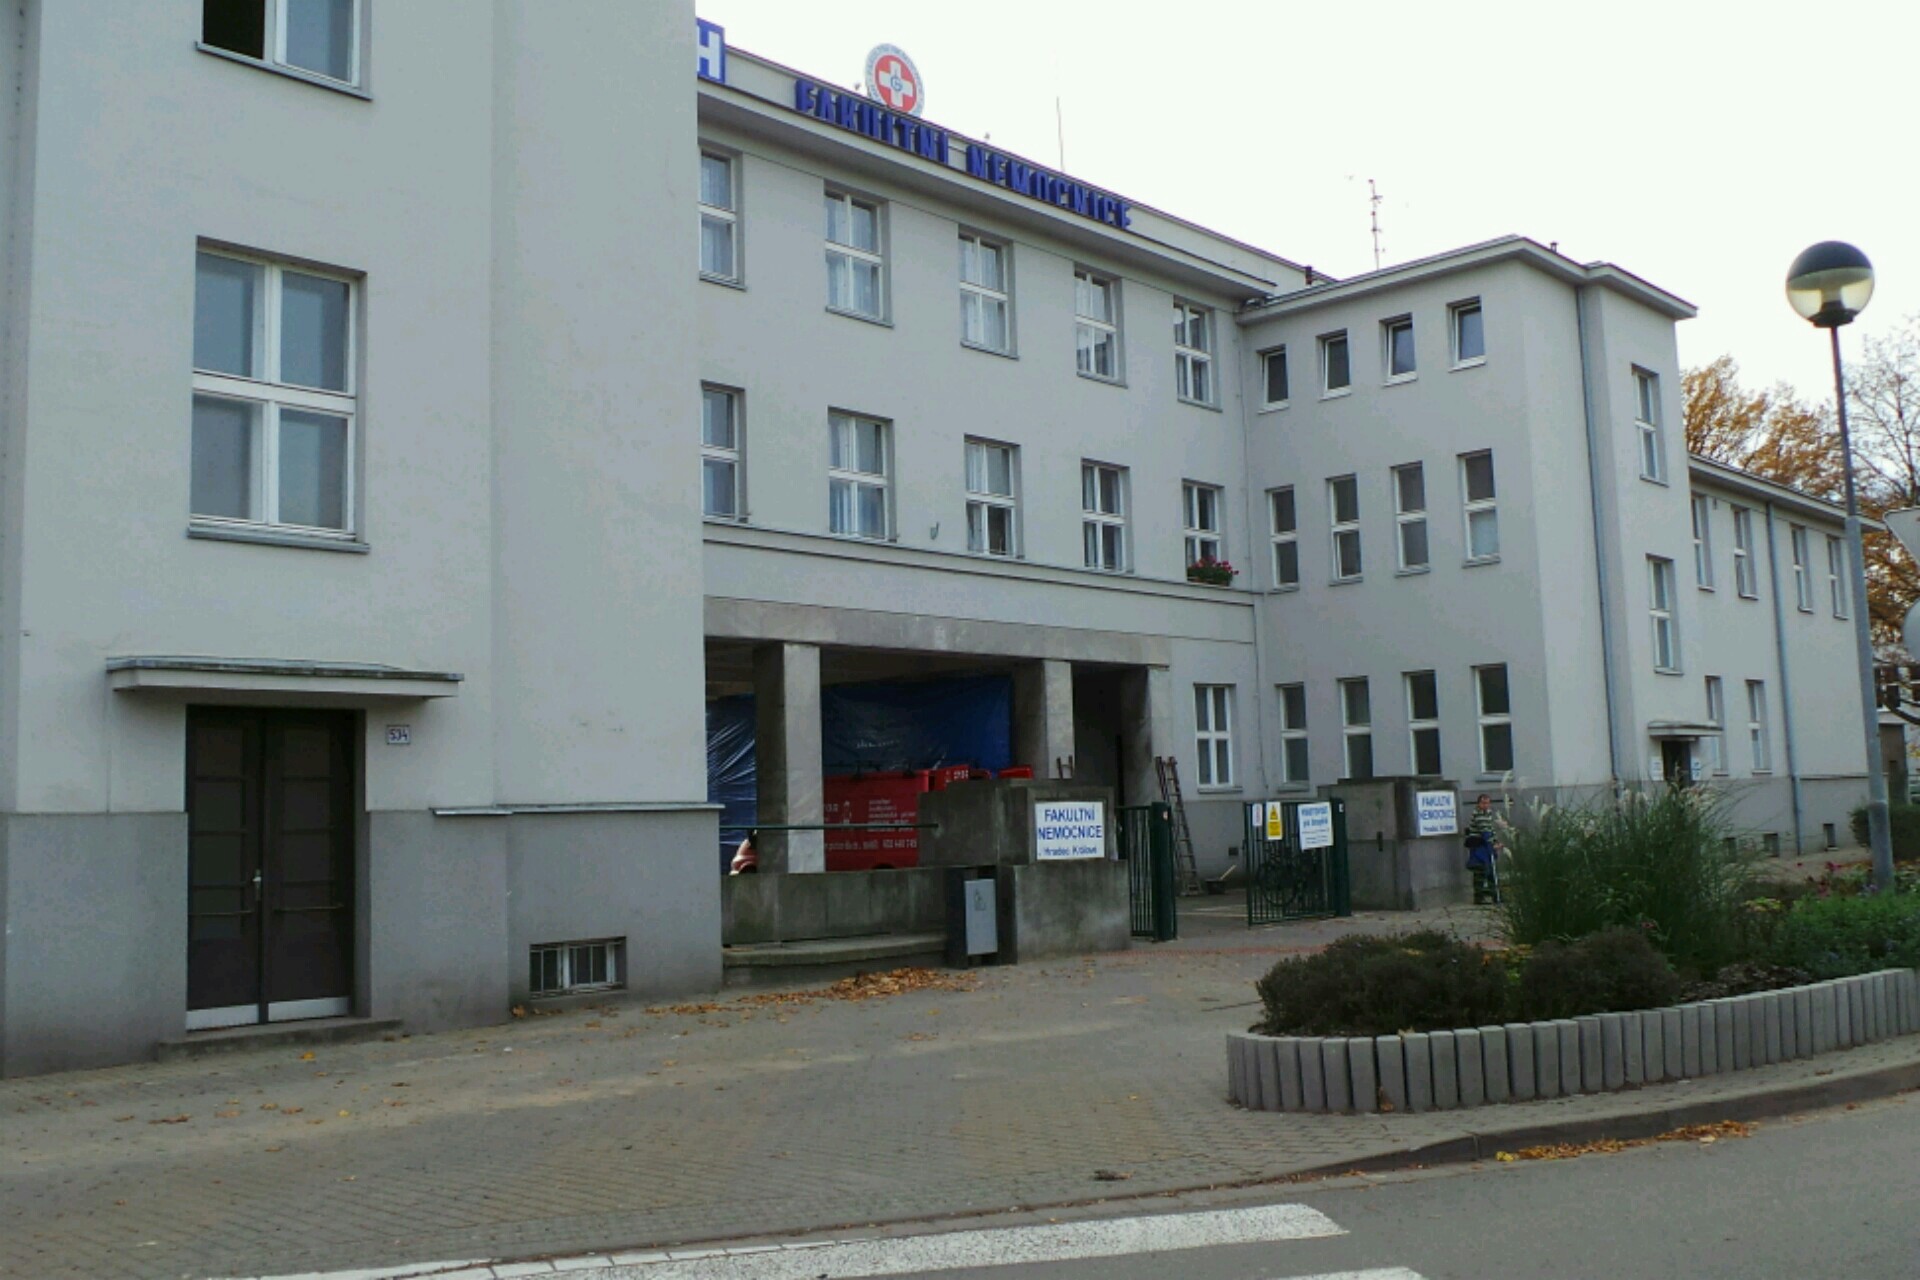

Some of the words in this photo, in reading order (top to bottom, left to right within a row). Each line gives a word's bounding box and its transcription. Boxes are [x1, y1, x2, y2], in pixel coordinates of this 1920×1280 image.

[966, 144, 1132, 230] NEMOCNICE
[1044, 804, 1095, 822] FAKULTNÍ
[1038, 825, 1103, 840] NEMOCNICE
